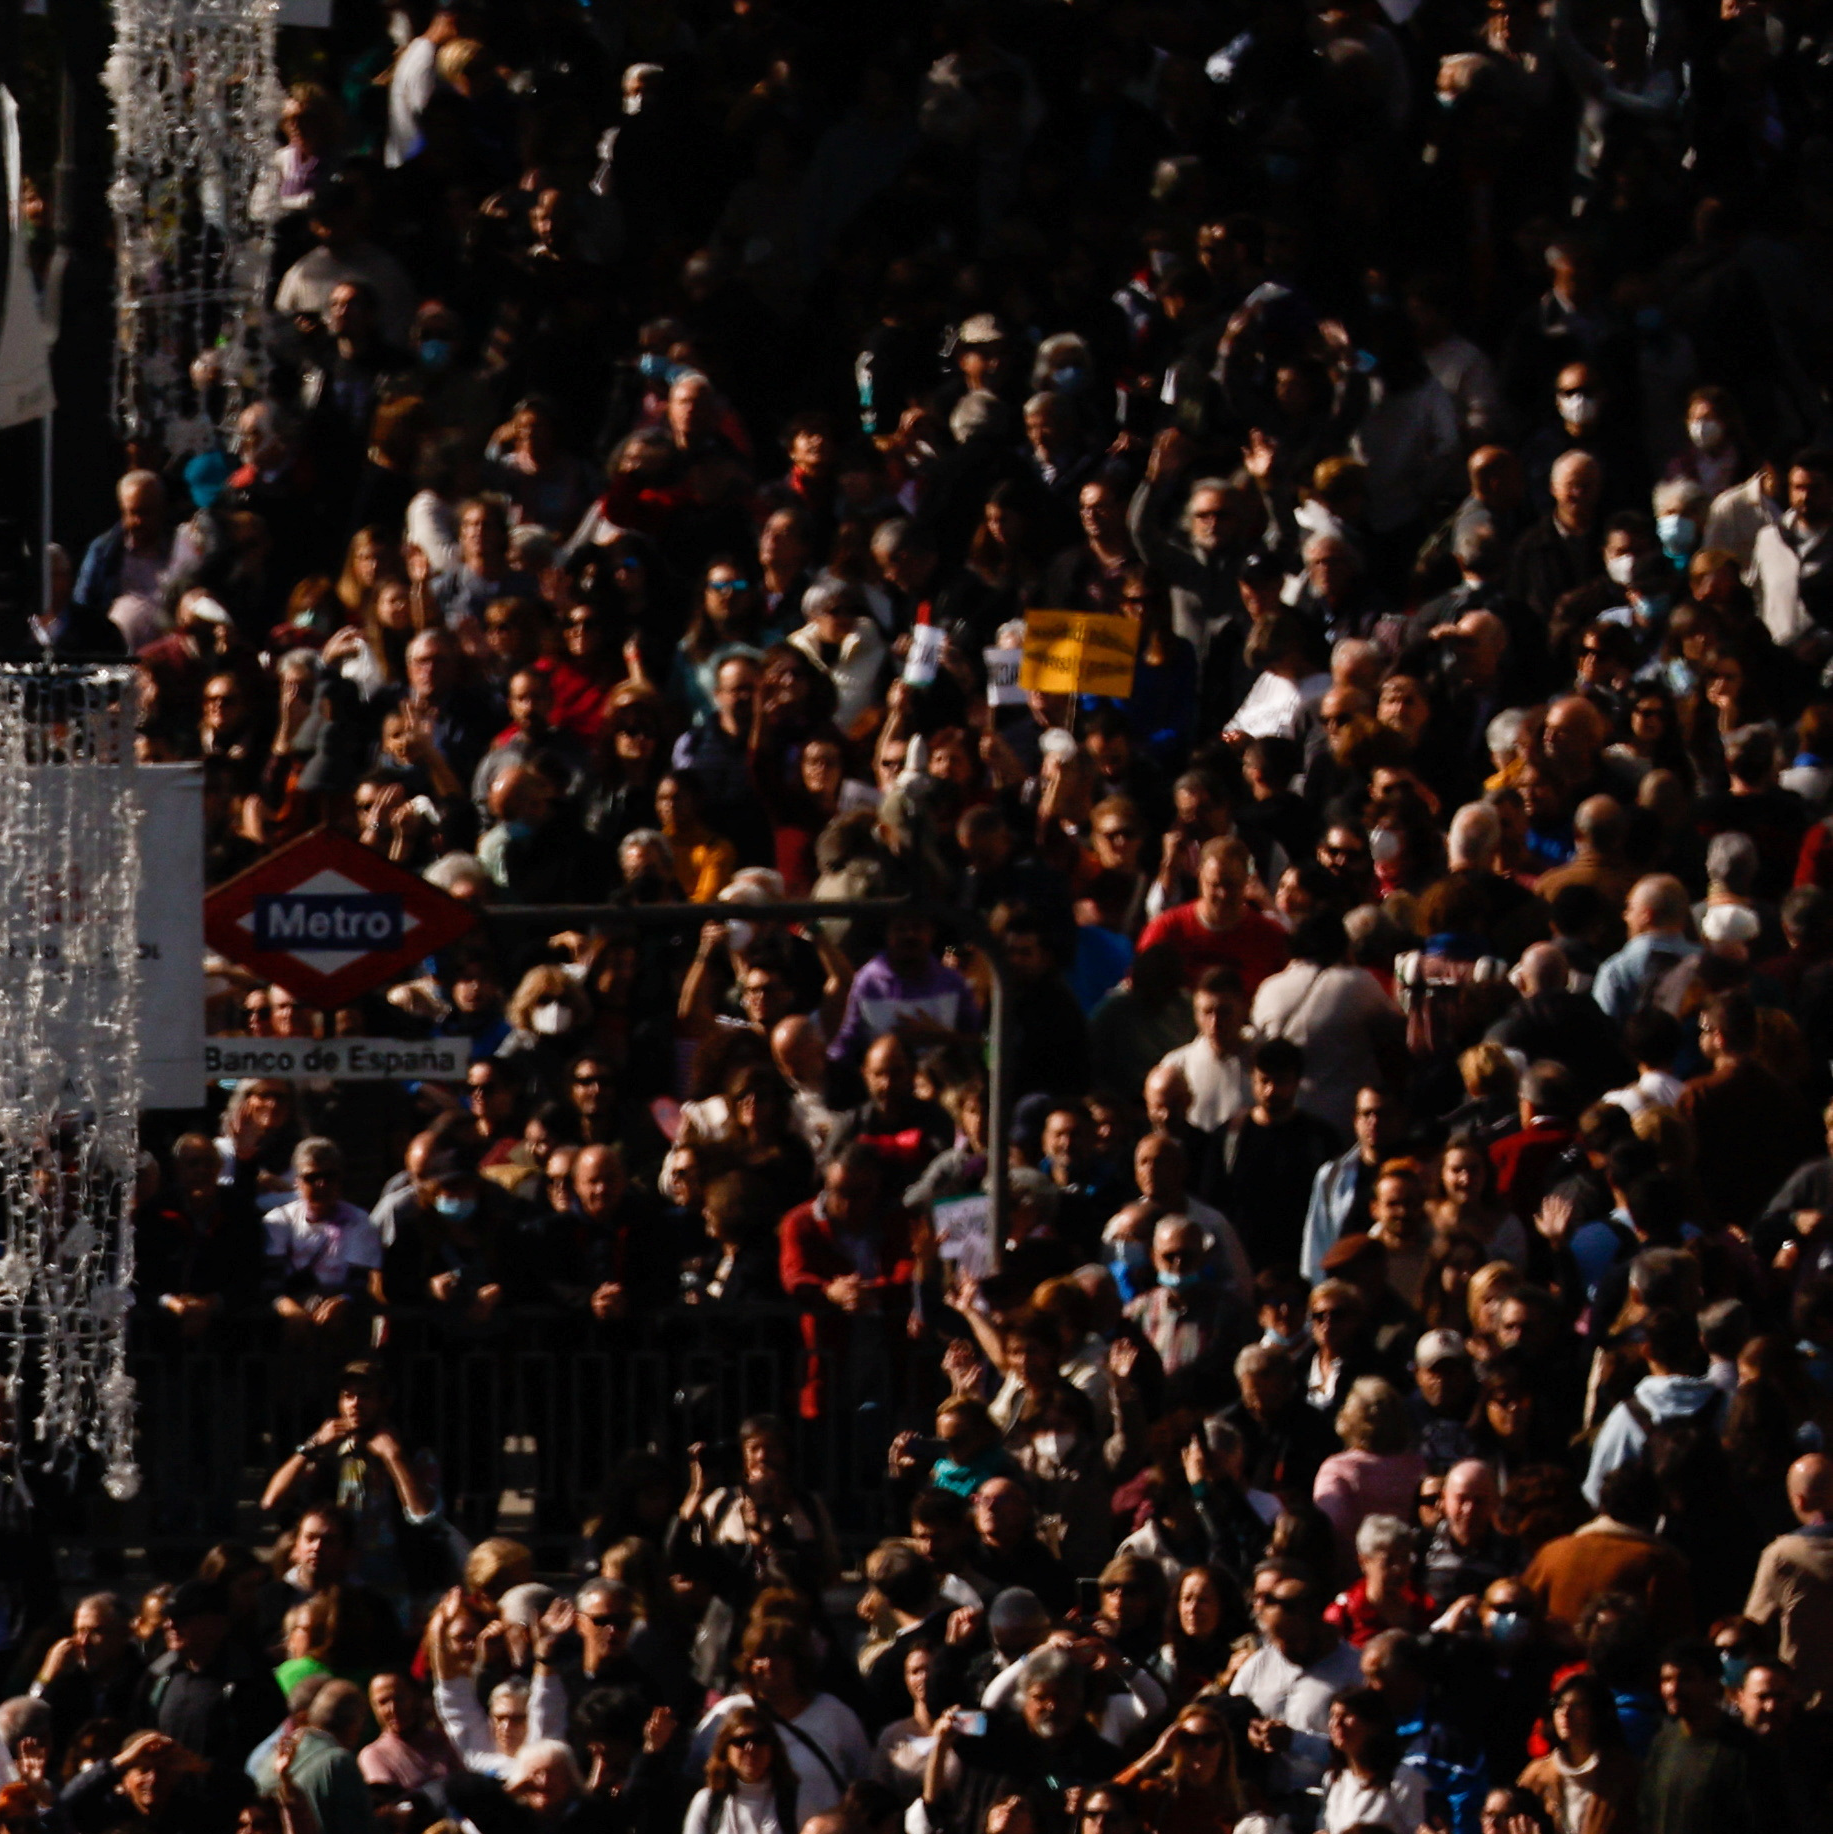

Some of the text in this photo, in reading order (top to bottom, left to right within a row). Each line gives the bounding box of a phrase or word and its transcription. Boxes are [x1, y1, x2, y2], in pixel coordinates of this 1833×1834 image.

[267, 902, 392, 941] Metro
[205, 1046, 456, 1078] Banco de España
